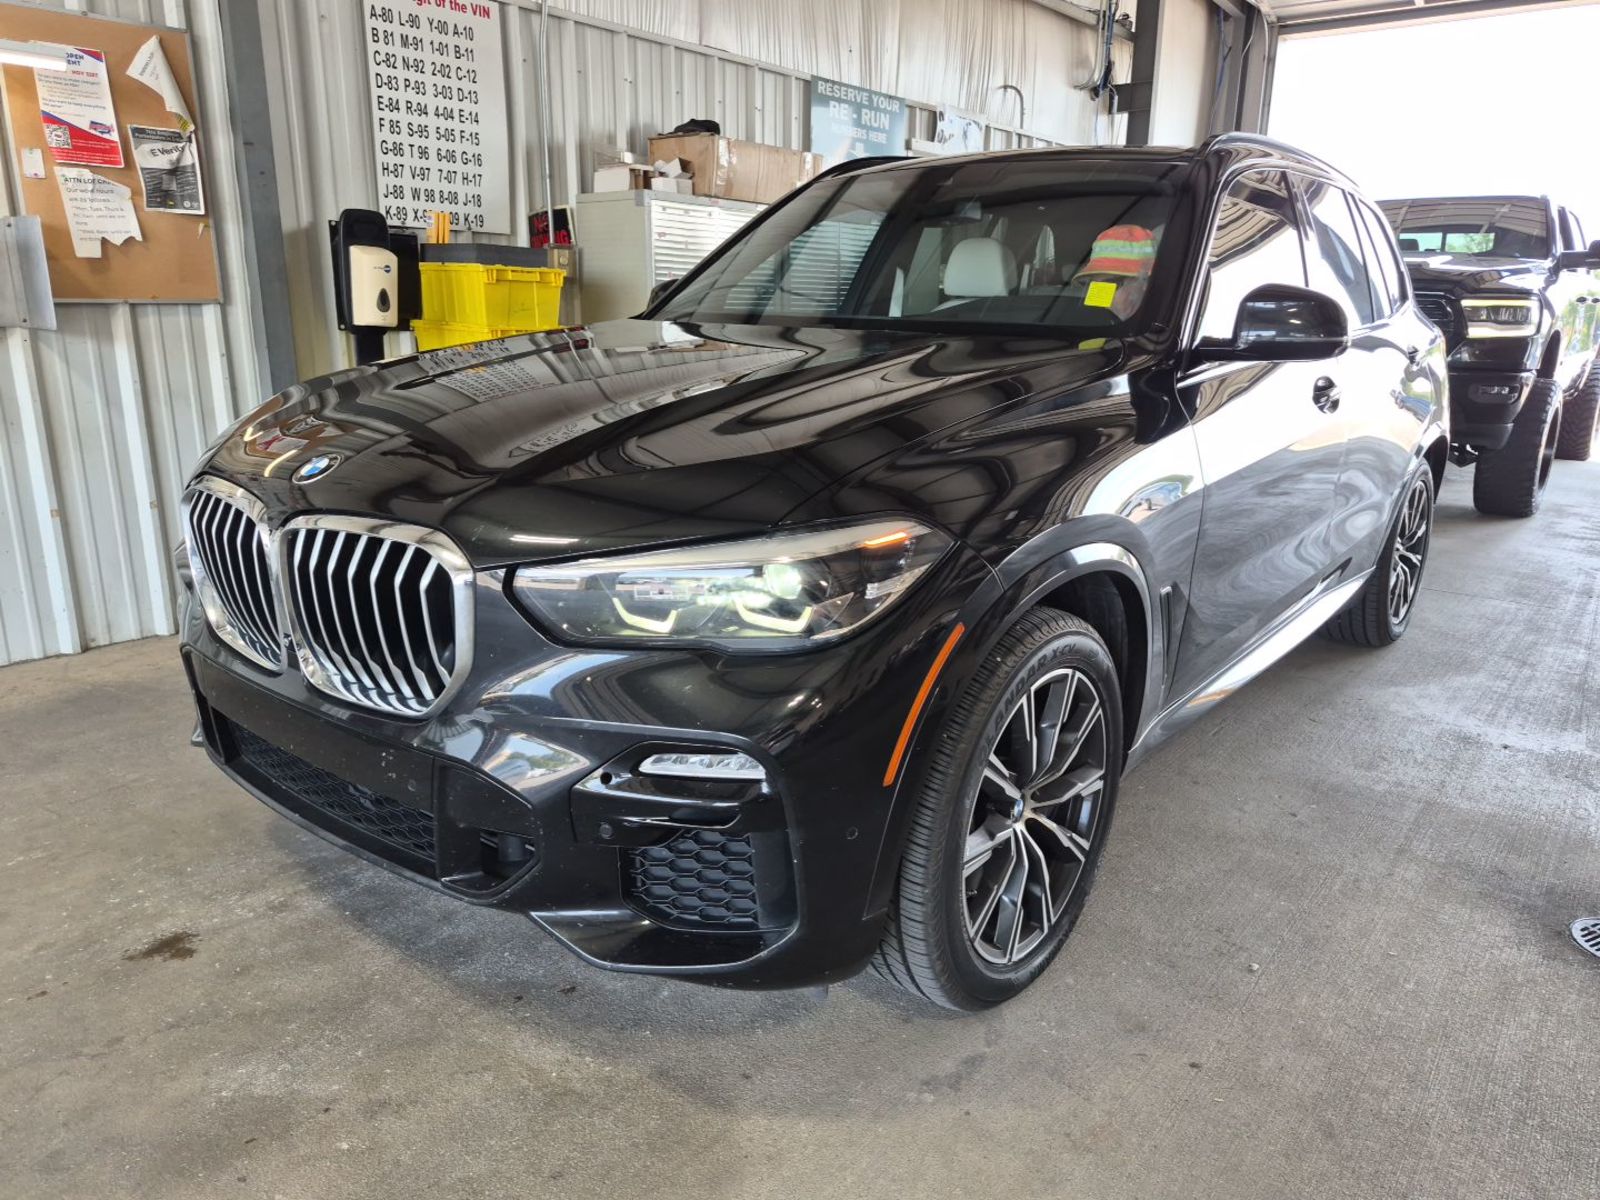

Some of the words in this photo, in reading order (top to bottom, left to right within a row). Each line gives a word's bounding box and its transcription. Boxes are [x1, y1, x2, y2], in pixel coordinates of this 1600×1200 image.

[370, 4, 393, 24] A-80
[398, 11, 420, 29] L-90
[428, 17, 448, 36] Y-00
[452, 23, 474, 41] A-10
[435, 0, 446, 8] of
[450, 0, 467, 13] the
[470, 3, 490, 19] VIN
[372, 27, 380, 43] B
[383, 30, 394, 46] 81
[400, 33, 424, 52] M-91
[430, 40, 448, 57] 1-01
[454, 45, 474, 62] B-11
[373, 50, 398, 69] C-82
[402, 56, 425, 74] N-92
[431, 62, 452, 79] 2-02
[456, 66, 477, 84] C-12
[375, 73, 399, 91] D-83
[404, 78, 426, 96] P-93
[432, 83, 453, 100] 3-03
[457, 88, 478, 104] D-13
[818, 81, 869, 105] RESERVE
[872, 95, 900, 112] YOUR
[377, 95, 400, 113] E-84
[406, 100, 428, 117] R-94
[434, 105, 454, 121] 4-04
[458, 109, 479, 125] E-14
[829, 101, 849, 120] RE
[862, 108, 890, 130] RUN
[379, 118, 385, 132] F
[389, 120, 401, 135] 85
[408, 122, 430, 139] S-95
[436, 127, 456, 142] 5-05
[460, 130, 480, 146] F-15
[380, 140, 404, 157] G-86
[408, 144, 414, 158] T
[418, 146, 430, 160] 96
[436, 148, 456, 164] 6-06
[461, 151, 482, 167] G-16
[382, 162, 404, 179] H-87
[410, 166, 430, 181] V-97
[438, 169, 457, 184] 7-07
[462, 172, 482, 187] H-17
[384, 184, 404, 200] J-88
[411, 187, 420, 201] W
[424, 189, 436, 203] 98
[439, 190, 458, 205] 8-08
[463, 193, 482, 208] J-18
[385, 205, 407, 221] K-89
[464, 213, 484, 228] K-19
